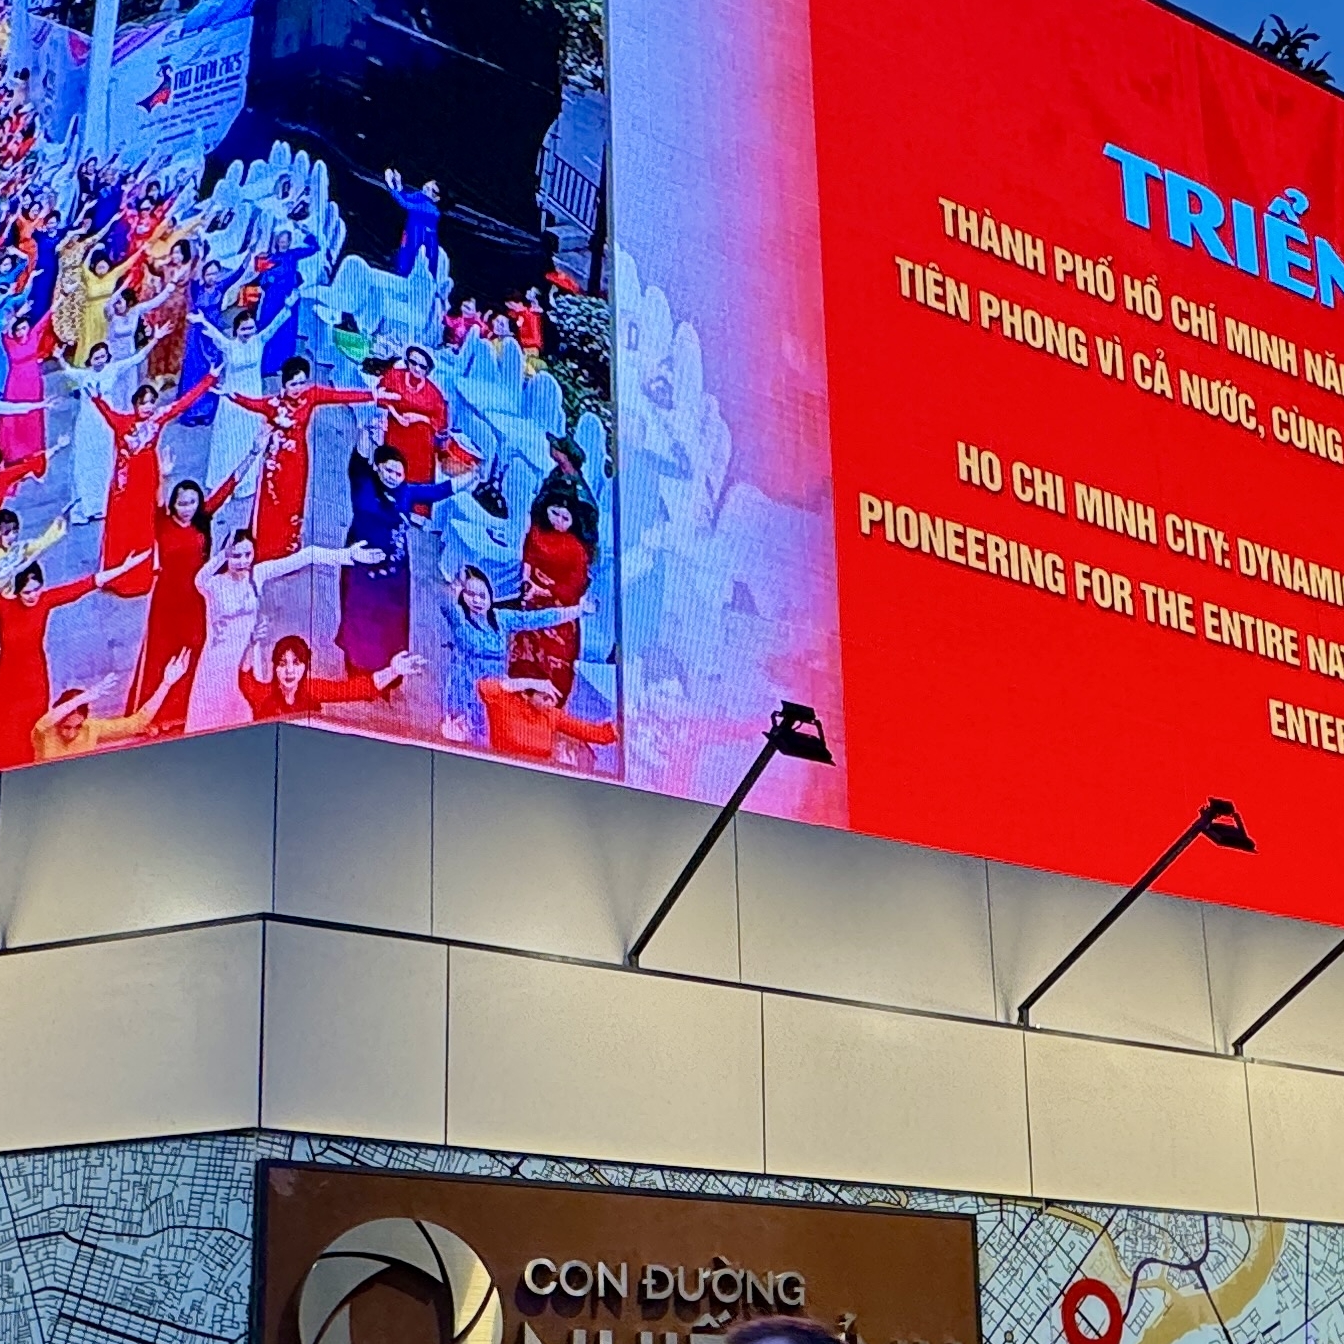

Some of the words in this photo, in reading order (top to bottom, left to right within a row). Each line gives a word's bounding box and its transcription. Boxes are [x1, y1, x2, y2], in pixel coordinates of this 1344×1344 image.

[895, 256, 971, 322] TIÊN
[979, 289, 1090, 367] PHONG
[1095, 335, 1125, 381] VÌ
[1133, 348, 1174, 400] CẢ
[1180, 368, 1266, 439] NƯỚC,
[1271, 404, 1344, 466] CÙNG
[938, 196, 1046, 275] THÀNH
[1054, 245, 1115, 303] PHỐ
[1123, 274, 1164, 323] HỒ
[1171, 296, 1219, 345] CHÍ
[1224, 316, 1299, 377] MINH
[858, 491, 1067, 596] PIONEERING
[1074, 560, 1134, 617] FOR
[1140, 581, 1196, 635] THE
[1203, 601, 1301, 667] ENTIRE
[956, 440, 1003, 493] HO
[1011, 461, 1066, 515] CHI
[1074, 480, 1158, 546] MINH
[1164, 513, 1232, 570] CITY:
[524, 1257, 628, 1298] CON
[641, 1255, 807, 1306] ĐƯỜNG
